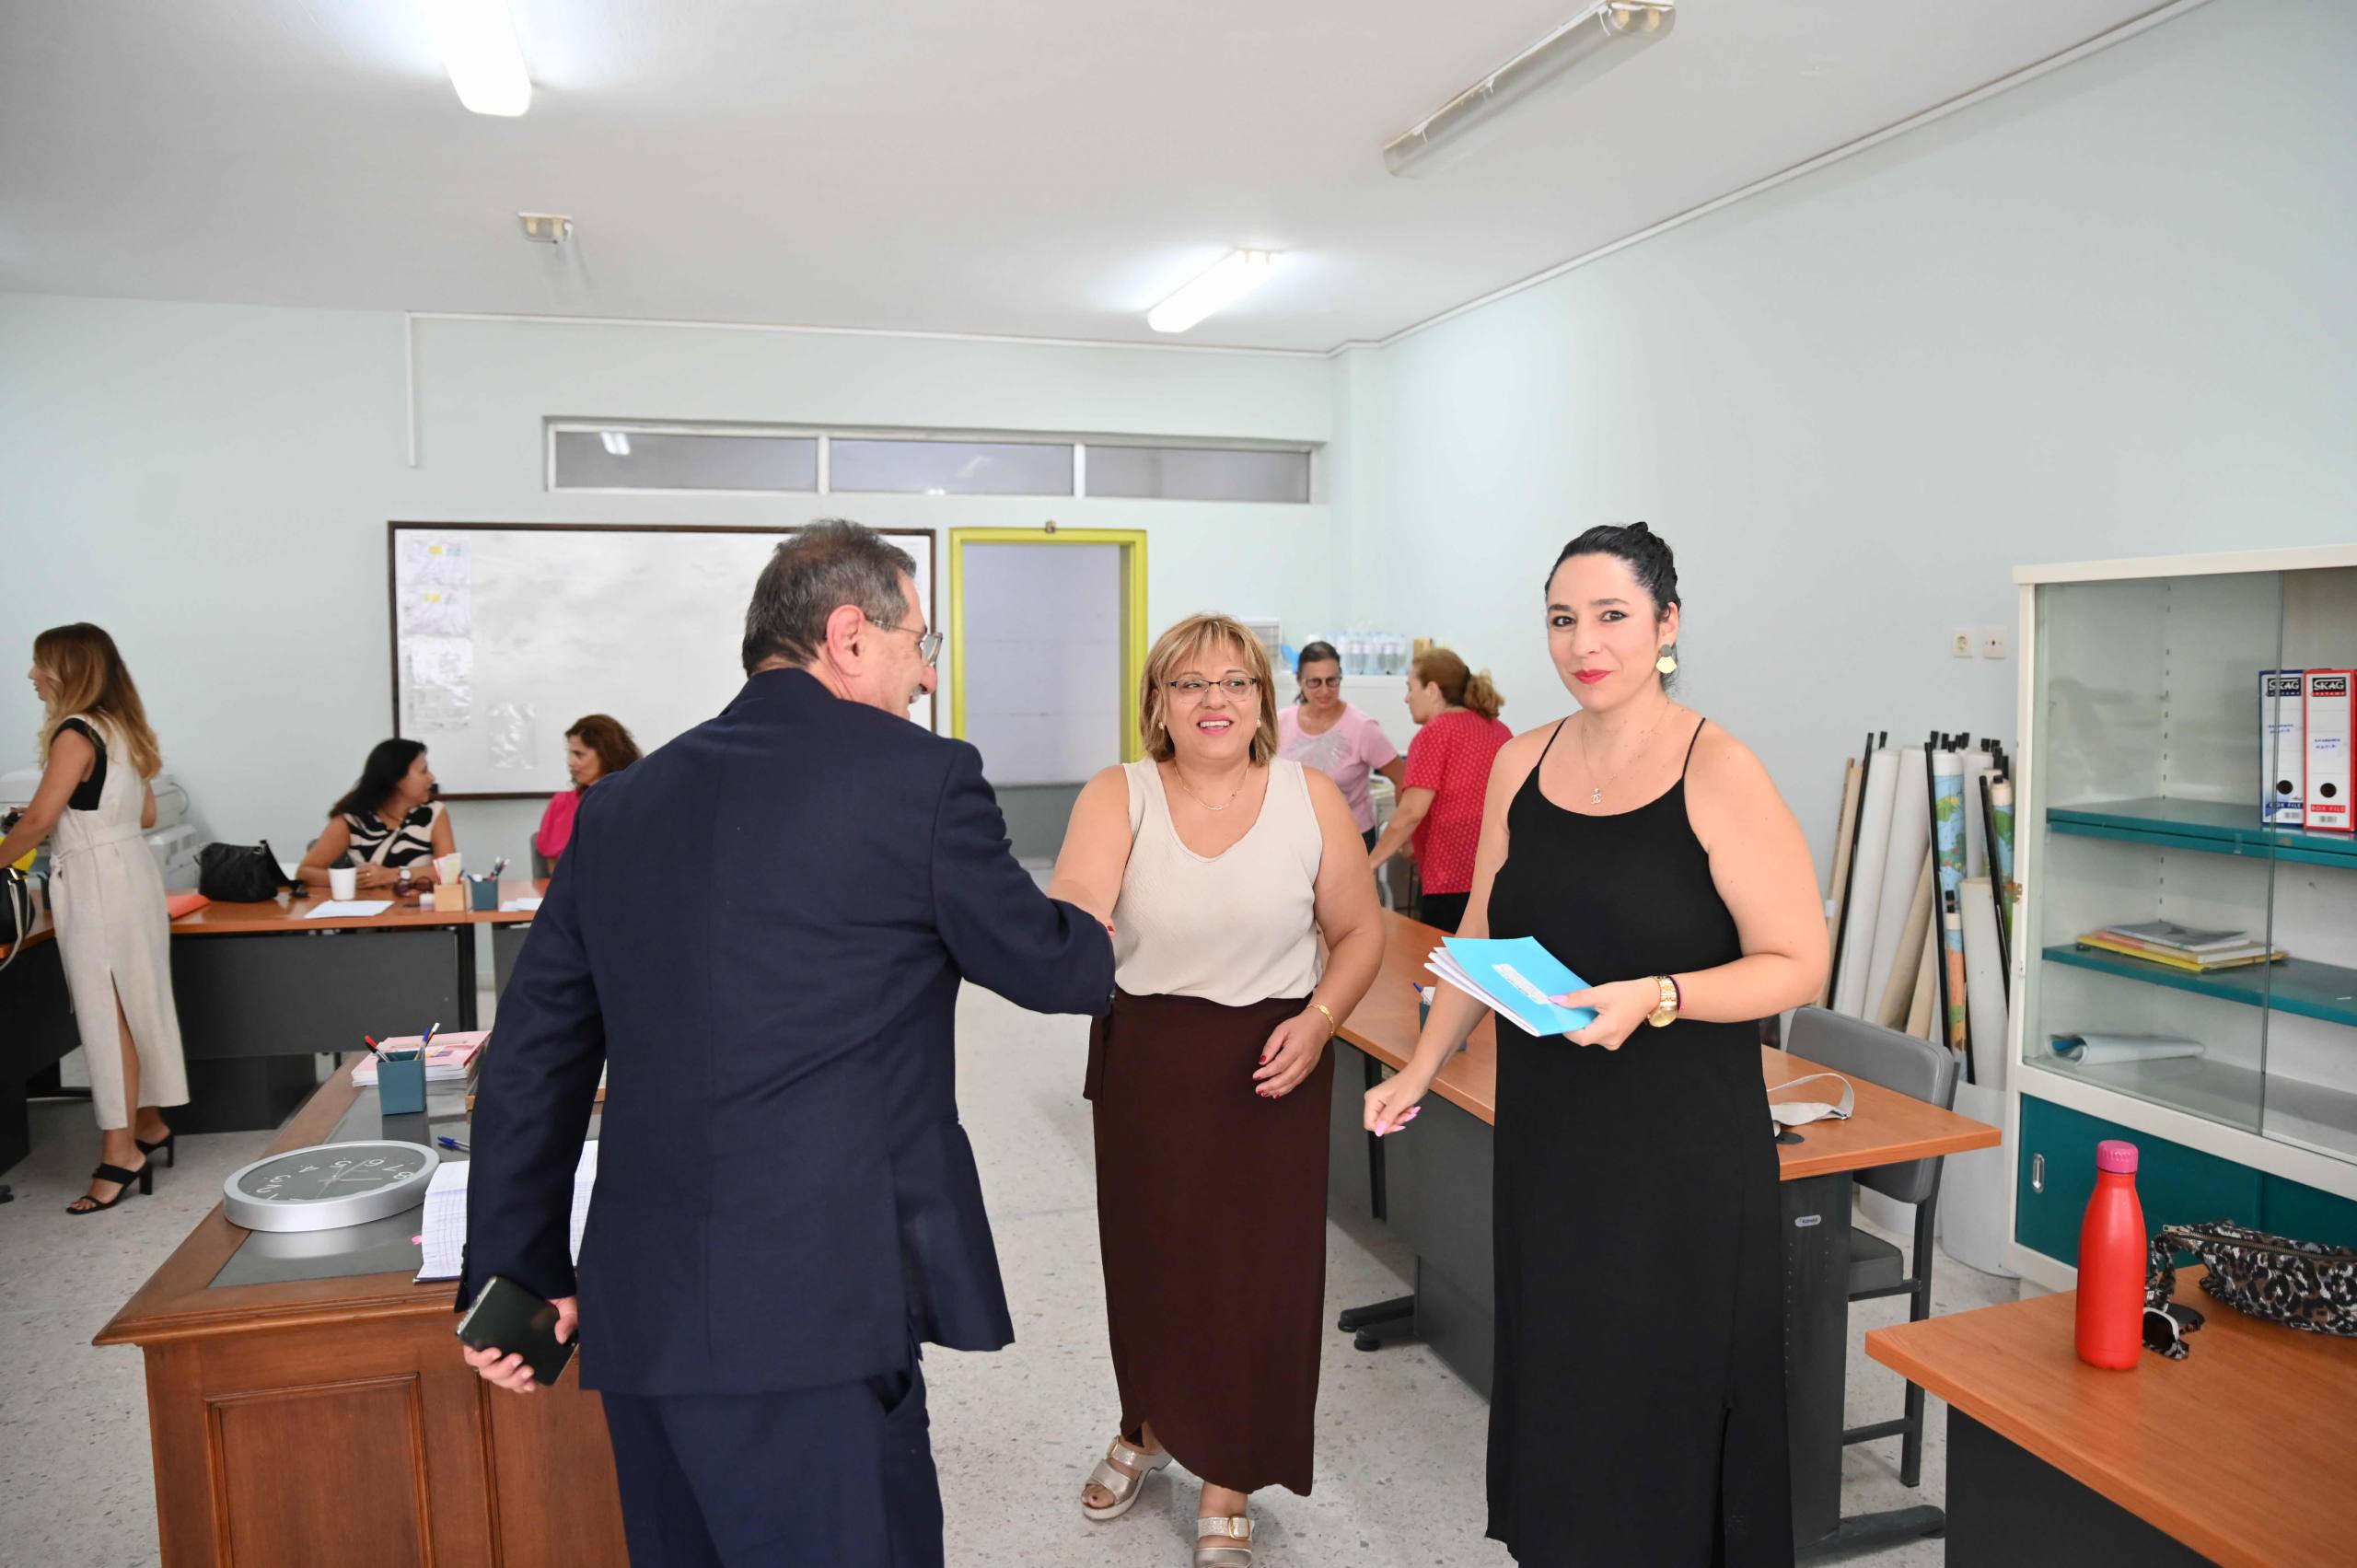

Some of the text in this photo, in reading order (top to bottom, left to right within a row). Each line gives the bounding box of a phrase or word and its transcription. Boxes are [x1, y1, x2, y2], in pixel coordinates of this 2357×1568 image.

[2268, 678, 2300, 691] SKAG
[2313, 677, 2345, 691] SKAG
[329, 1160, 353, 1168] 5
[368, 1158, 385, 1167] 6
[297, 1165, 319, 1174] 4
[270, 1174, 292, 1184] 3
[393, 1170, 414, 1180] 8
